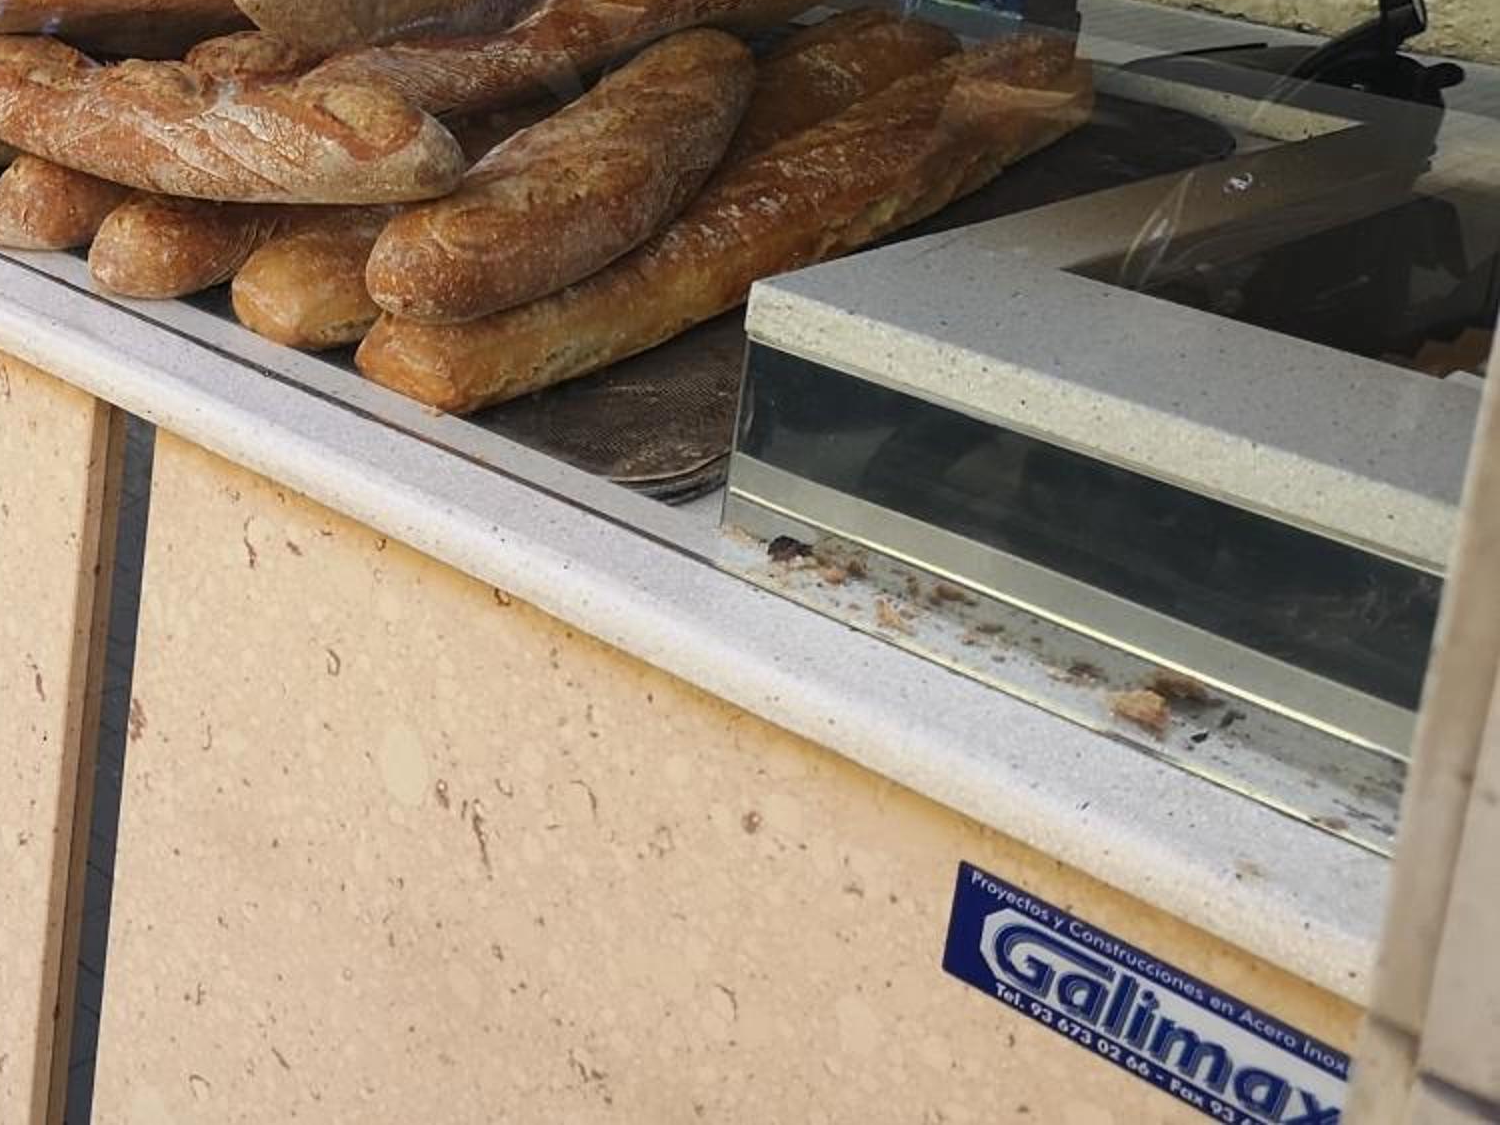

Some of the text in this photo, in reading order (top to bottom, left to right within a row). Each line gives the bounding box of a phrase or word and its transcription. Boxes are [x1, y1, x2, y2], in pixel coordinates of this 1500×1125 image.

[971, 870, 1049, 921] Proyectos
[1054, 915, 1064, 930] y
[1069, 921, 1204, 1002] Construcciones
[1209, 997, 1235, 1017] en
[1239, 1009, 1296, 1048] Acero
[993, 921, 1341, 1125] Galimax
[995, 982, 1025, 1009] Tel.
[1030, 1001, 1053, 1022] 93
[1057, 1018, 1092, 1045] 673
[1097, 1039, 1121, 1061] 02
[1125, 1055, 1150, 1076] 66
[1169, 1079, 1204, 1107] Fax
[1209, 1100, 1236, 1123] 93
